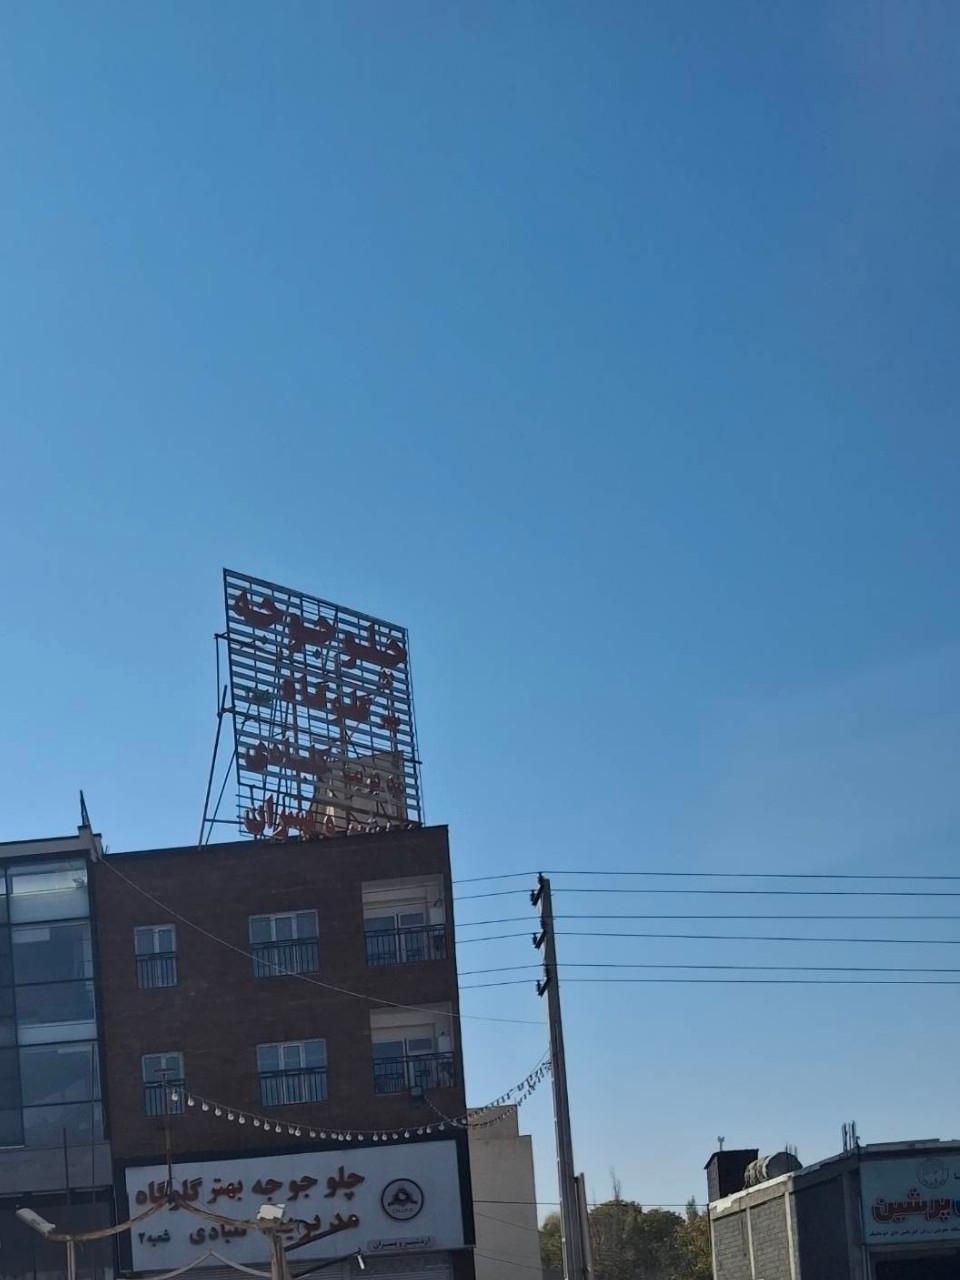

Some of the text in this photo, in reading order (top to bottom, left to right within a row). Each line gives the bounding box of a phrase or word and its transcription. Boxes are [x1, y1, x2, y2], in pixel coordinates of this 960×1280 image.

[136, 1166, 365, 1211] چلو جوجه بهتر گلوگاه
[872, 1186, 952, 1223] پرشین
[147, 1229, 171, 1247] شعبه
[262, 1212, 360, 1242] مدیری
